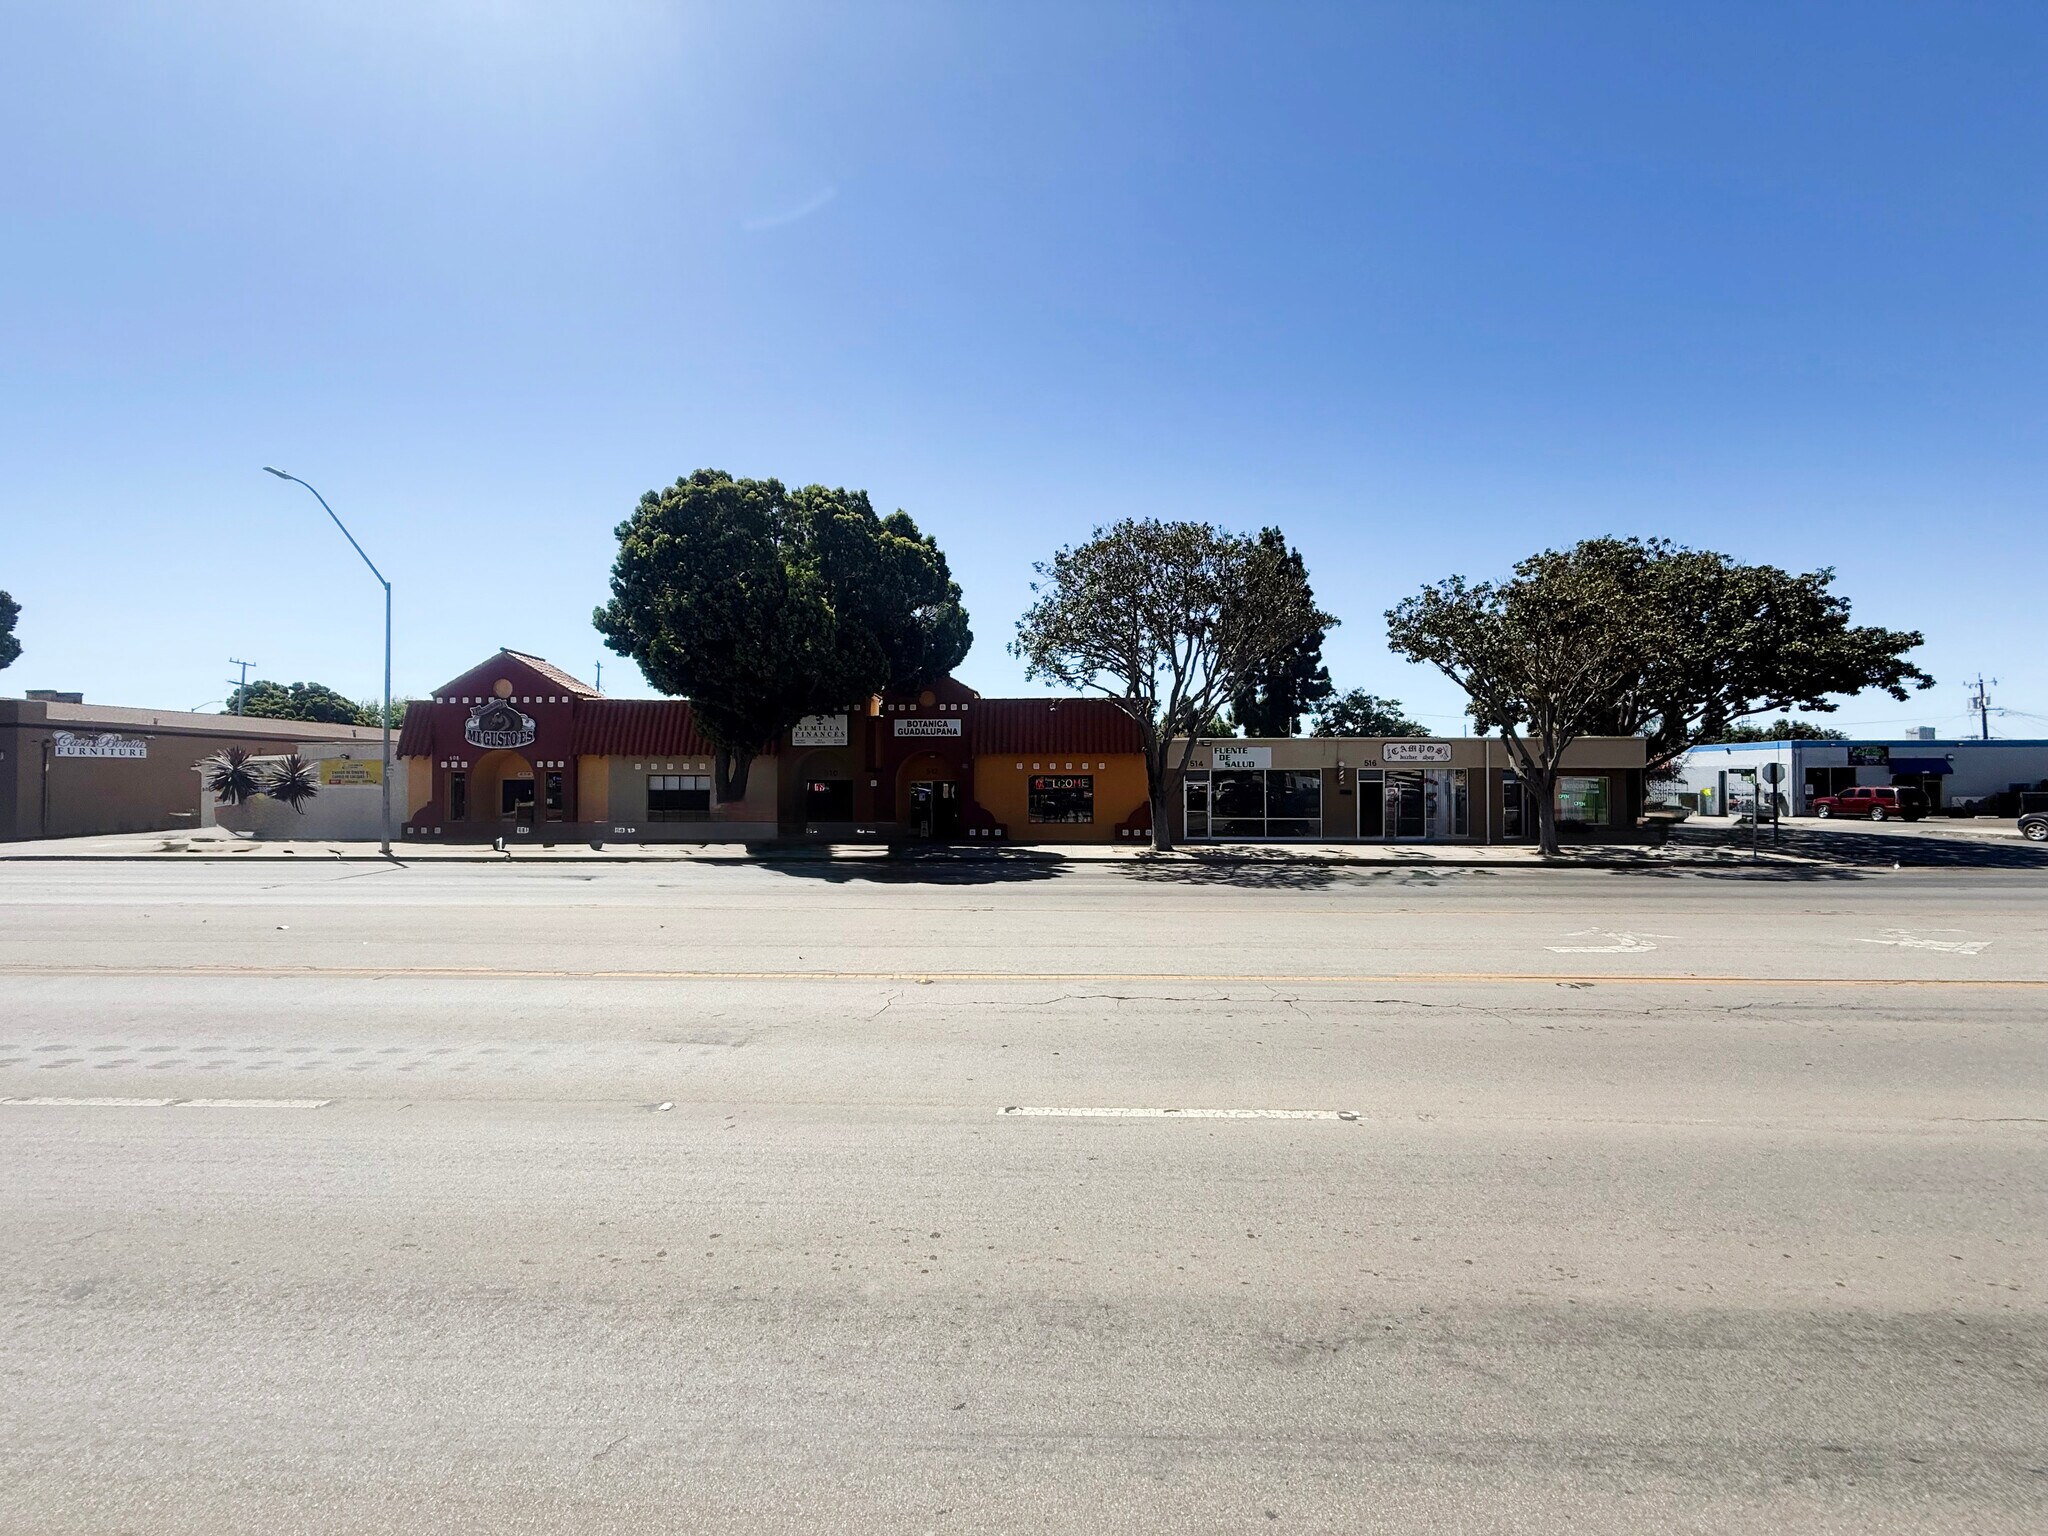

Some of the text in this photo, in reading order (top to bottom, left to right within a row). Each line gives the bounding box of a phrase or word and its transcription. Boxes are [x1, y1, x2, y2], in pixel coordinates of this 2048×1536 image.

[906, 720, 948, 728] BOTANICA
[897, 728, 958, 736] GUADALUPANA
[54, 731, 146, 748] Casa Bonita
[467, 730, 533, 746] MI GUSTO ES
[57, 747, 146, 756] FURNITURE
[1391, 744, 1443, 756] CAMPOS
